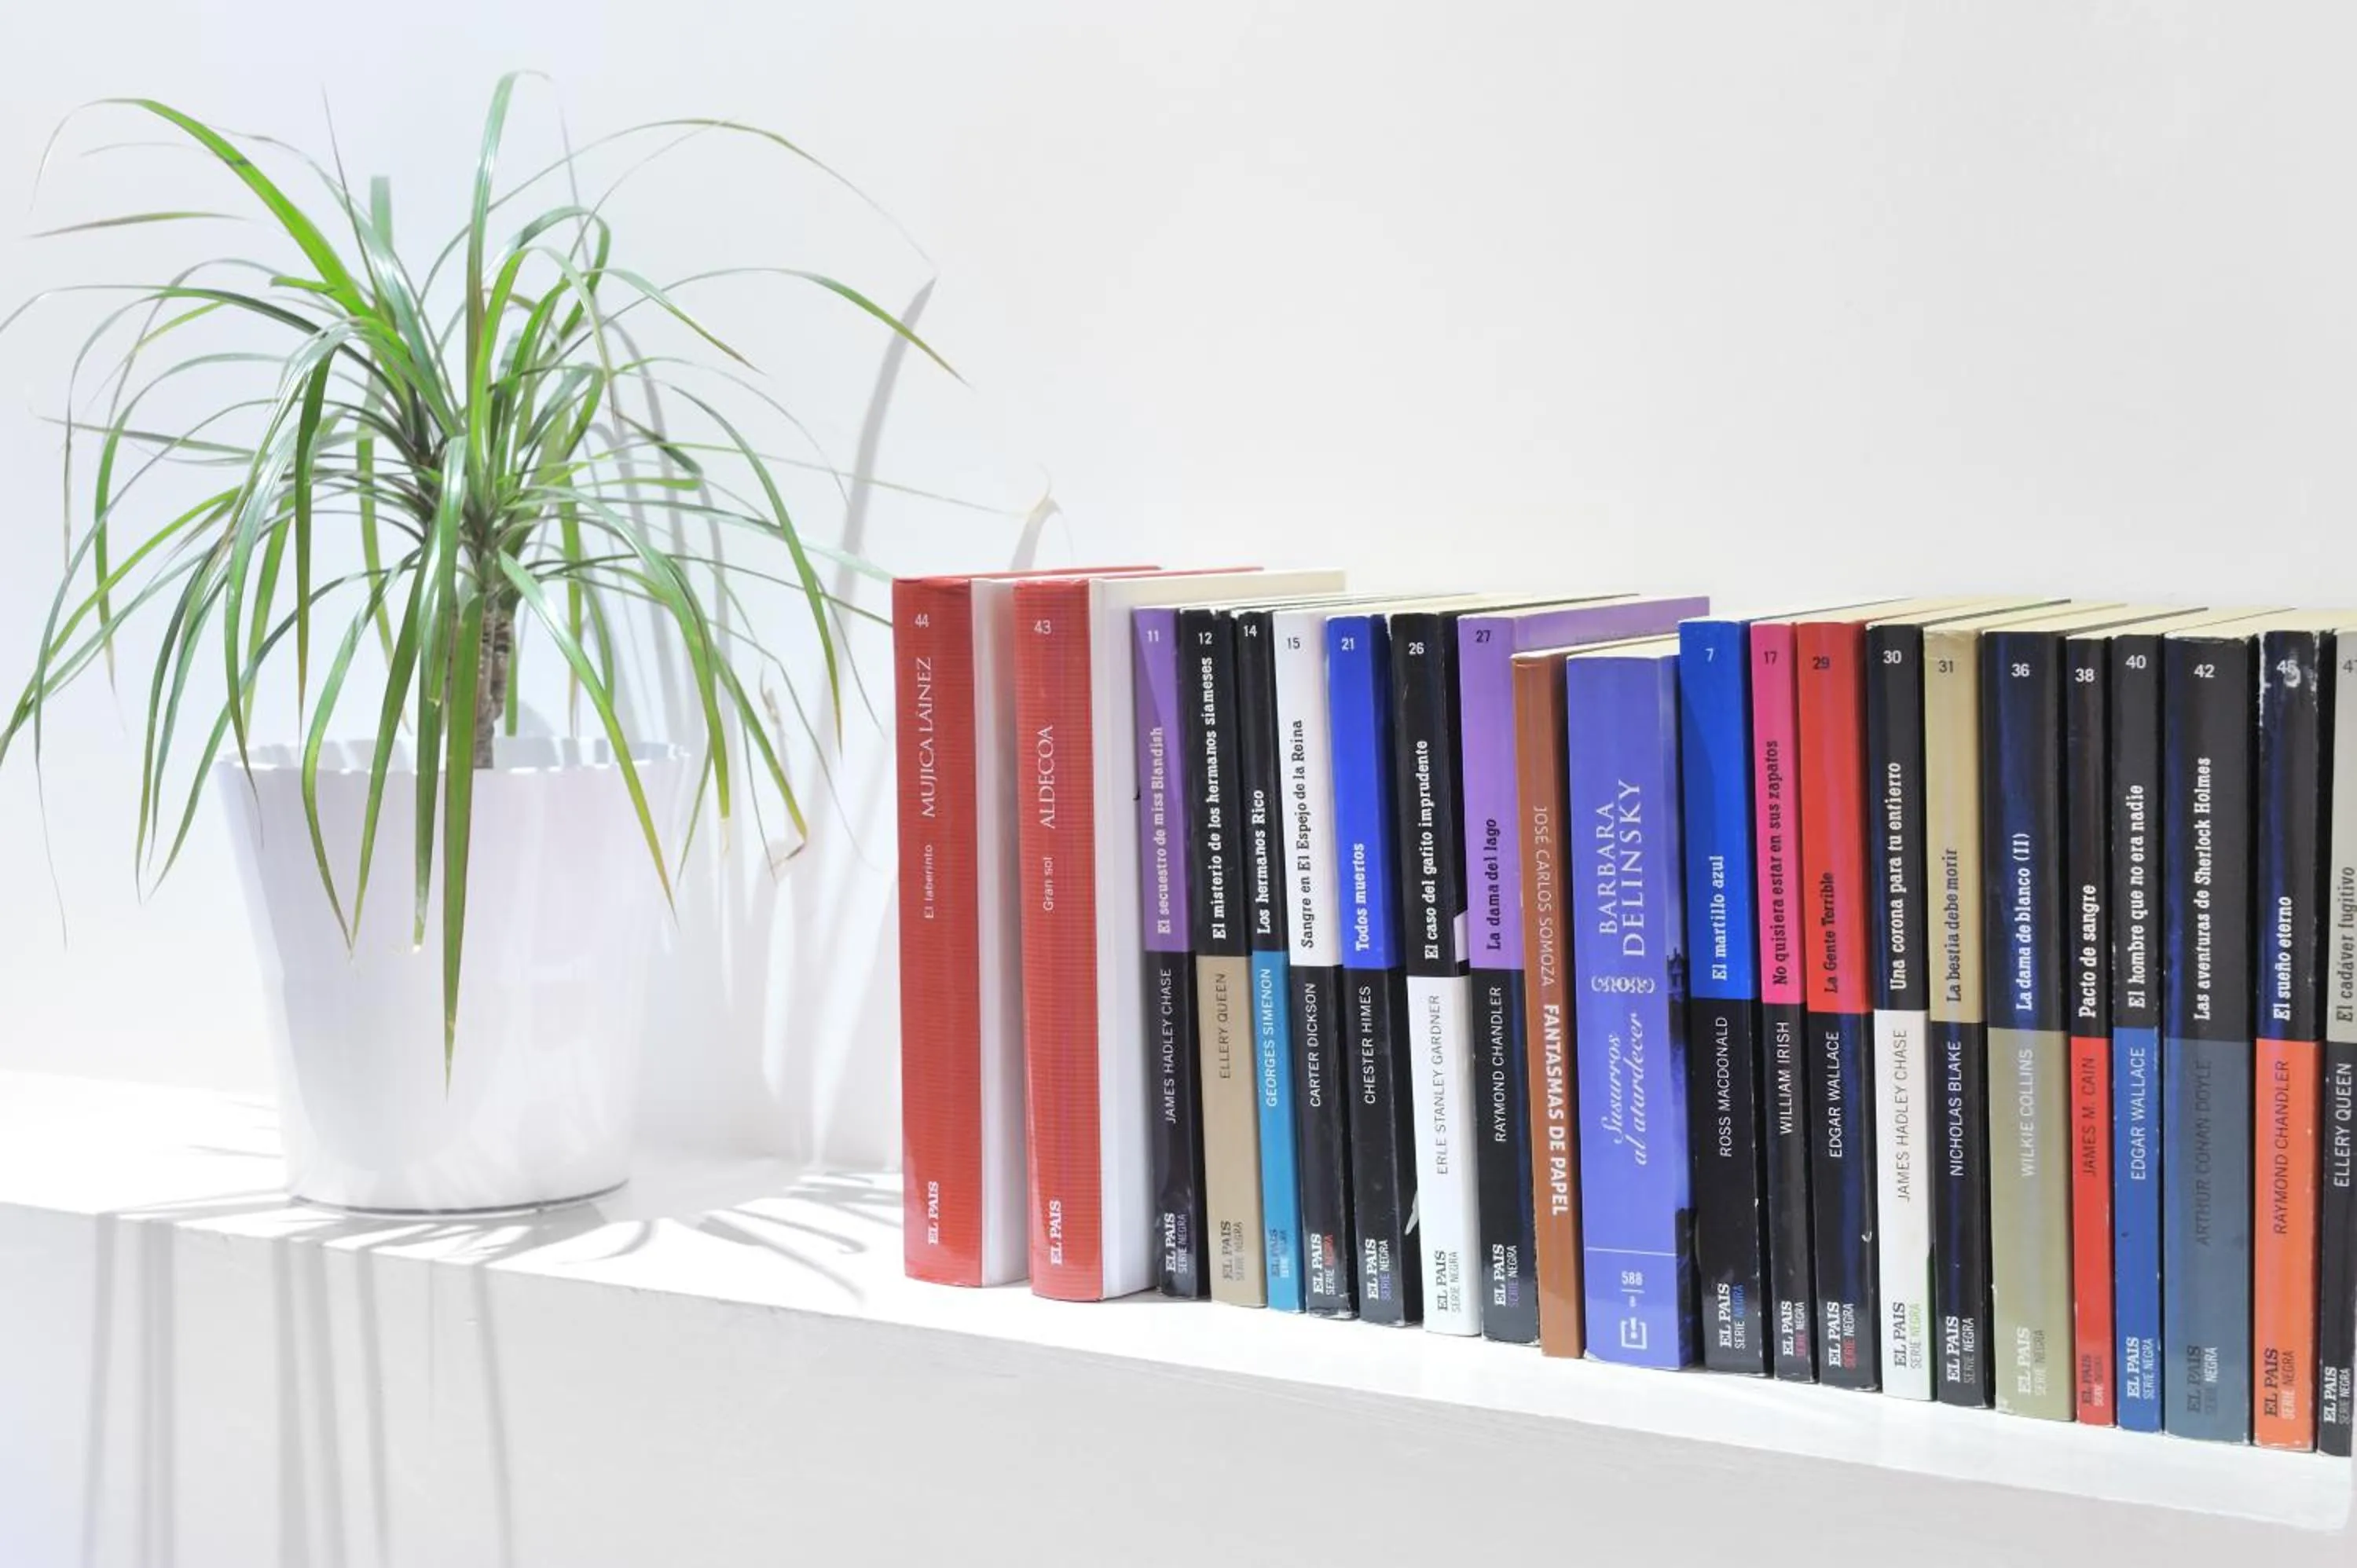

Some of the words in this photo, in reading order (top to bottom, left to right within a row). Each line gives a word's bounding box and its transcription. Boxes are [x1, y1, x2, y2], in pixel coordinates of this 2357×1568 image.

[915, 614, 929, 628] 44
[1034, 620, 1051, 635] 43
[1147, 630, 1160, 642] 11
[1198, 632, 1212, 645] 12
[1243, 625, 1258, 637] 14
[1475, 629, 1491, 643] 27
[1286, 637, 1300, 650] 15
[1340, 637, 1355, 650] 21
[1408, 641, 1425, 655] 26
[1706, 648, 1714, 661] 7
[1763, 651, 1777, 664] 17
[1882, 650, 1902, 664] 30
[2125, 654, 2146, 669] 40
[1938, 660, 1954, 673] 31
[2011, 663, 2030, 677] 36
[2074, 668, 2095, 683] 38
[2194, 664, 2215, 678] 42
[1200, 657, 1216, 725] siameses
[1149, 727, 1165, 789] Blandish
[1289, 720, 1306, 762] Reina
[918, 738, 938, 818] MUJICA
[1036, 725, 1056, 829] ALDECOA
[1205, 731, 1221, 803] hermanos
[1292, 766, 1306, 780] la
[1414, 740, 1435, 827] imprudente
[1764, 740, 1784, 799] zapatos
[2193, 757, 2212, 814] Holmes
[1150, 793, 1165, 826] miss
[1251, 789, 1266, 825] Rico
[1292, 783, 1307, 800] de
[1884, 762, 1903, 830] entierro
[2125, 785, 2146, 831] nadie
[1207, 807, 1222, 829] los
[1294, 802, 1312, 850] Espejo
[1482, 819, 1501, 851] lago
[1768, 804, 1782, 829] sus
[1152, 829, 1167, 846] de
[1207, 833, 1222, 851] de
[1418, 831, 1438, 875] gatito
[1769, 834, 1783, 853] en
[1886, 835, 1904, 852] tu
[2011, 833, 2031, 862] (II)
[2129, 836, 2146, 863] era
[2193, 819, 2212, 885] Sherlock
[923, 844, 934, 901] laberinto
[1043, 856, 1054, 876] sol
[1155, 848, 1171, 915] secuestro
[1254, 830, 1270, 903] hermanos
[1296, 855, 1312, 871] El
[1351, 843, 1368, 904] muertos
[1482, 856, 1500, 881] del
[1535, 849, 1552, 912] CARLOS
[1595, 802, 1618, 934] BARBARA
[1618, 779, 1645, 956] DELINSKY
[1708, 855, 1725, 889] azul
[1769, 855, 1785, 895] estar
[1888, 856, 1908, 893] para
[1941, 848, 1959, 890] morir
[2129, 866, 2145, 886] no
[1043, 879, 1054, 911] Gran
[1207, 855, 1226, 918] misterio
[1299, 876, 1312, 893] en
[1420, 880, 1436, 903] del
[1486, 884, 1501, 926] dama
[1818, 872, 1836, 927] Terrible
[2013, 867, 2032, 921] blanco
[2129, 890, 2149, 920] que
[2192, 889, 2211, 909] de
[2337, 866, 2357, 929] fugitivo
[923, 906, 934, 919] El
[1157, 919, 1171, 934] El
[1211, 923, 1226, 940] El
[1256, 909, 1271, 934] Los
[1299, 898, 1316, 949] Sangre
[1354, 907, 1370, 951] Todos
[1425, 907, 1439, 940] caso
[1709, 893, 1728, 958] martillo
[1769, 899, 1791, 962] quisiera
[1890, 899, 1906, 953] corona
[1943, 893, 1961, 930] debe
[2081, 884, 2101, 941] sangre
[2275, 896, 2293, 948] eterno
[1424, 944, 1439, 960] El
[1485, 932, 1501, 951] La
[1538, 917, 1556, 987] SOMOZA
[1821, 931, 1838, 972] Gente
[2014, 925, 2033, 943] de
[2127, 925, 2146, 984] hombre
[2194, 914, 2212, 989] aventuras
[1710, 964, 1728, 980] El
[1772, 965, 1789, 986] No
[1889, 959, 1908, 991] Una
[1943, 933, 1962, 981] bestia
[2014, 947, 2033, 989] dama
[2078, 947, 2098, 967] de
[2274, 952, 2293, 998] sueño
[2337, 935, 2355, 1000] cadáver
[1160, 969, 1174, 1016] CHASE
[1215, 973, 1229, 1023] QUEEN
[1259, 969, 1274, 1035] SIMENON
[1823, 976, 1838, 994] La
[1945, 984, 1962, 1002] La
[2014, 991, 2033, 1011] La
[2077, 971, 2097, 1018] Pacto
[2127, 991, 2146, 1009] El
[1303, 983, 1320, 1047] DICKSON
[1358, 986, 1373, 1033] HIMES
[1489, 987, 1505, 1067] CHANDLER
[2193, 994, 2211, 1020] Las
[2272, 1002, 2292, 1021] El
[2336, 1005, 2354, 1023] El
[1161, 1019, 1175, 1074] HADLEY
[1428, 995, 1444, 1065] GARDNER
[1776, 1022, 1791, 1064] IRISH
[1218, 1028, 1231, 1079] ELLERY
[1263, 1039, 1278, 1107] GEORGES
[1361, 1038, 1376, 1105] CHESTER
[1543, 1004, 1565, 1119] FANTASMAS
[1622, 1012, 1647, 1133] atardecer
[1714, 1017, 1731, 1112] MACDONALD
[1825, 1031, 1842, 1101] WALLACE
[1947, 1041, 1963, 1092] BLAKE
[1307, 1052, 1321, 1107] CARTER
[1600, 1032, 1623, 1145] Susurros
[2334, 1063, 2352, 1121] QUEEN
[1163, 1078, 1177, 1124] JAMES
[1431, 1069, 1447, 1133] STANLEY
[1491, 1071, 1507, 1142] RAYMOND
[1777, 1069, 1793, 1135] WILLIAM
[1548, 1126, 1566, 1151] DE
[1624, 1134, 1648, 1166] al
[1717, 1116, 1733, 1157] ROSS
[1827, 1107, 1843, 1158] EDGAR
[1948, 1097, 1964, 1176] NICHOLAS
[1435, 1139, 1449, 1174] ERLE
[2333, 1126, 2352, 1187] ELLERY
[1549, 1156, 1570, 1216] PAPEL
[927, 1222, 940, 1245] EL
[1366, 1278, 1380, 1299] EL
[1436, 1290, 1449, 1311] EL
[2140, 1338, 2155, 1369] NEGRA
[2126, 1376, 2141, 1398] EL
[2141, 1372, 2156, 1400] SERIE
